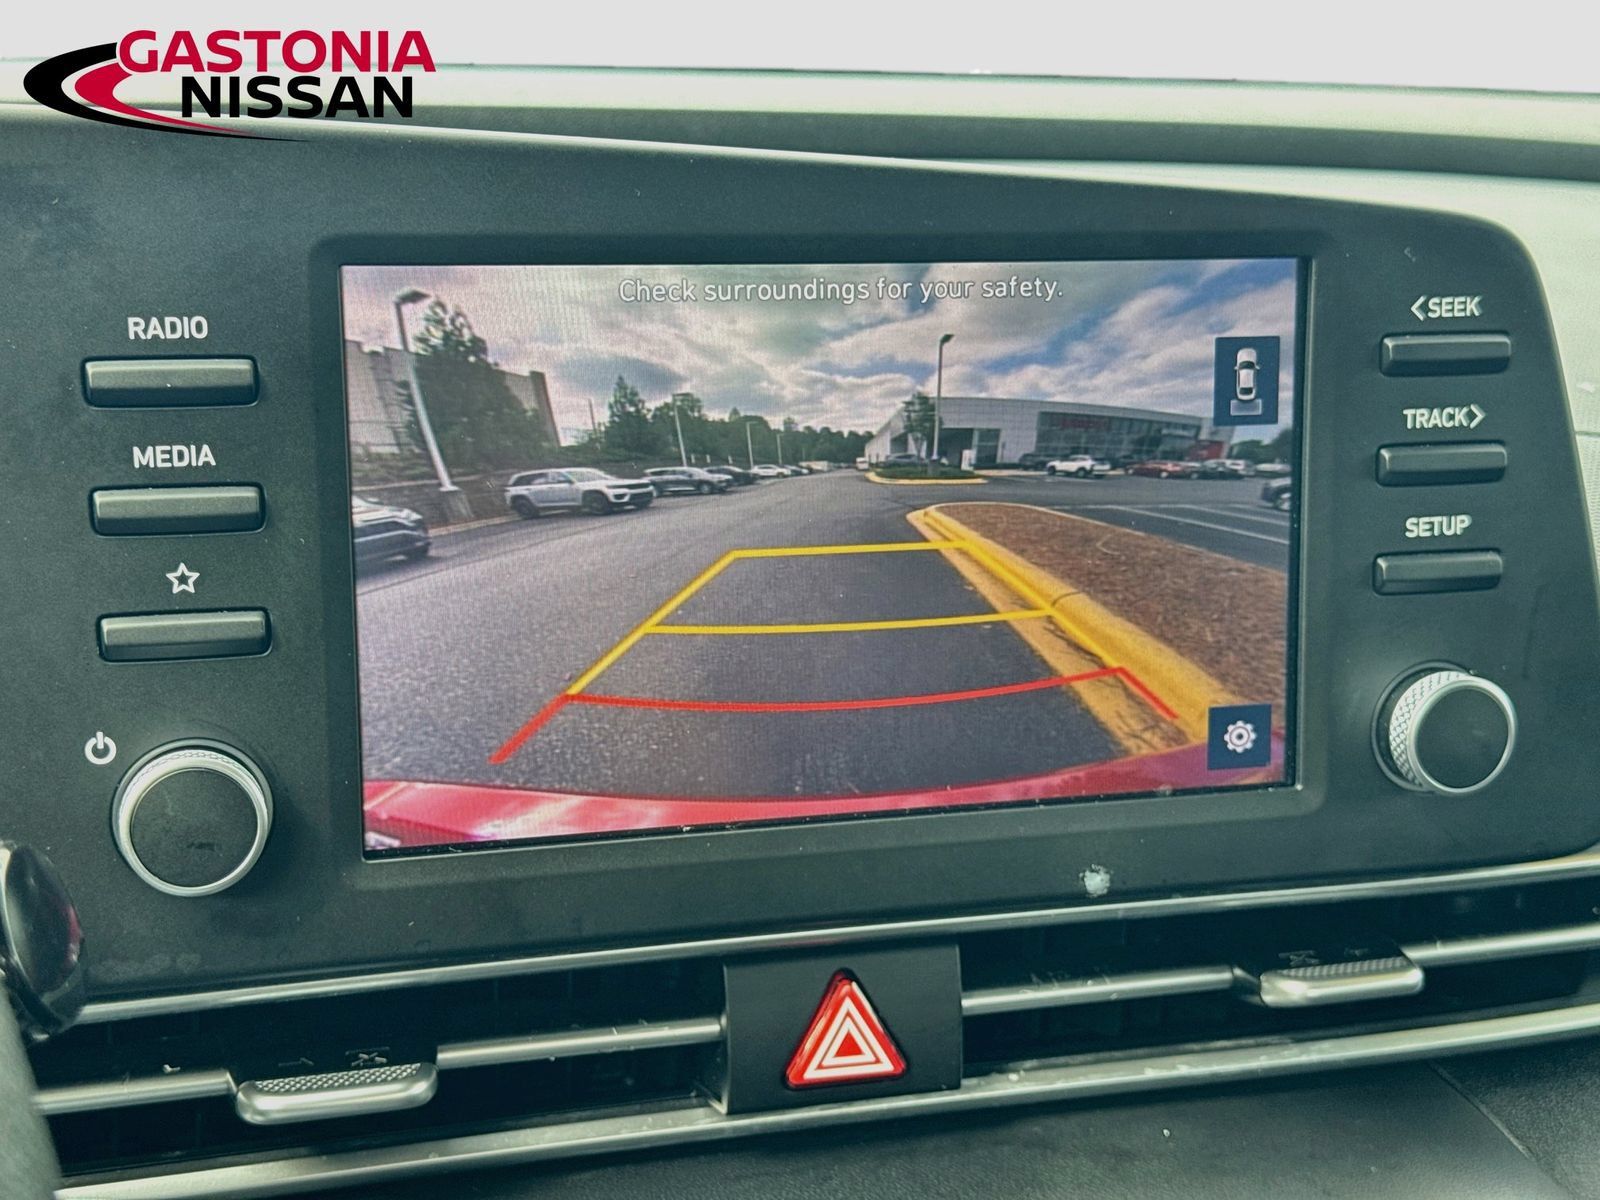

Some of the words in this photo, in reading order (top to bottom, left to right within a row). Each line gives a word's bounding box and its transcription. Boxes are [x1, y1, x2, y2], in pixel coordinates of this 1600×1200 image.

[618, 279, 697, 302] Check
[703, 278, 870, 305] surroundings
[876, 277, 913, 300] for
[919, 279, 975, 304] your
[981, 276, 1064, 302] safety.
[1427, 296, 1482, 318] SEEK
[127, 316, 209, 340] RADIO
[1402, 406, 1470, 430] TRACK
[132, 444, 217, 469] MEDIA
[1405, 514, 1472, 538] SETUP
